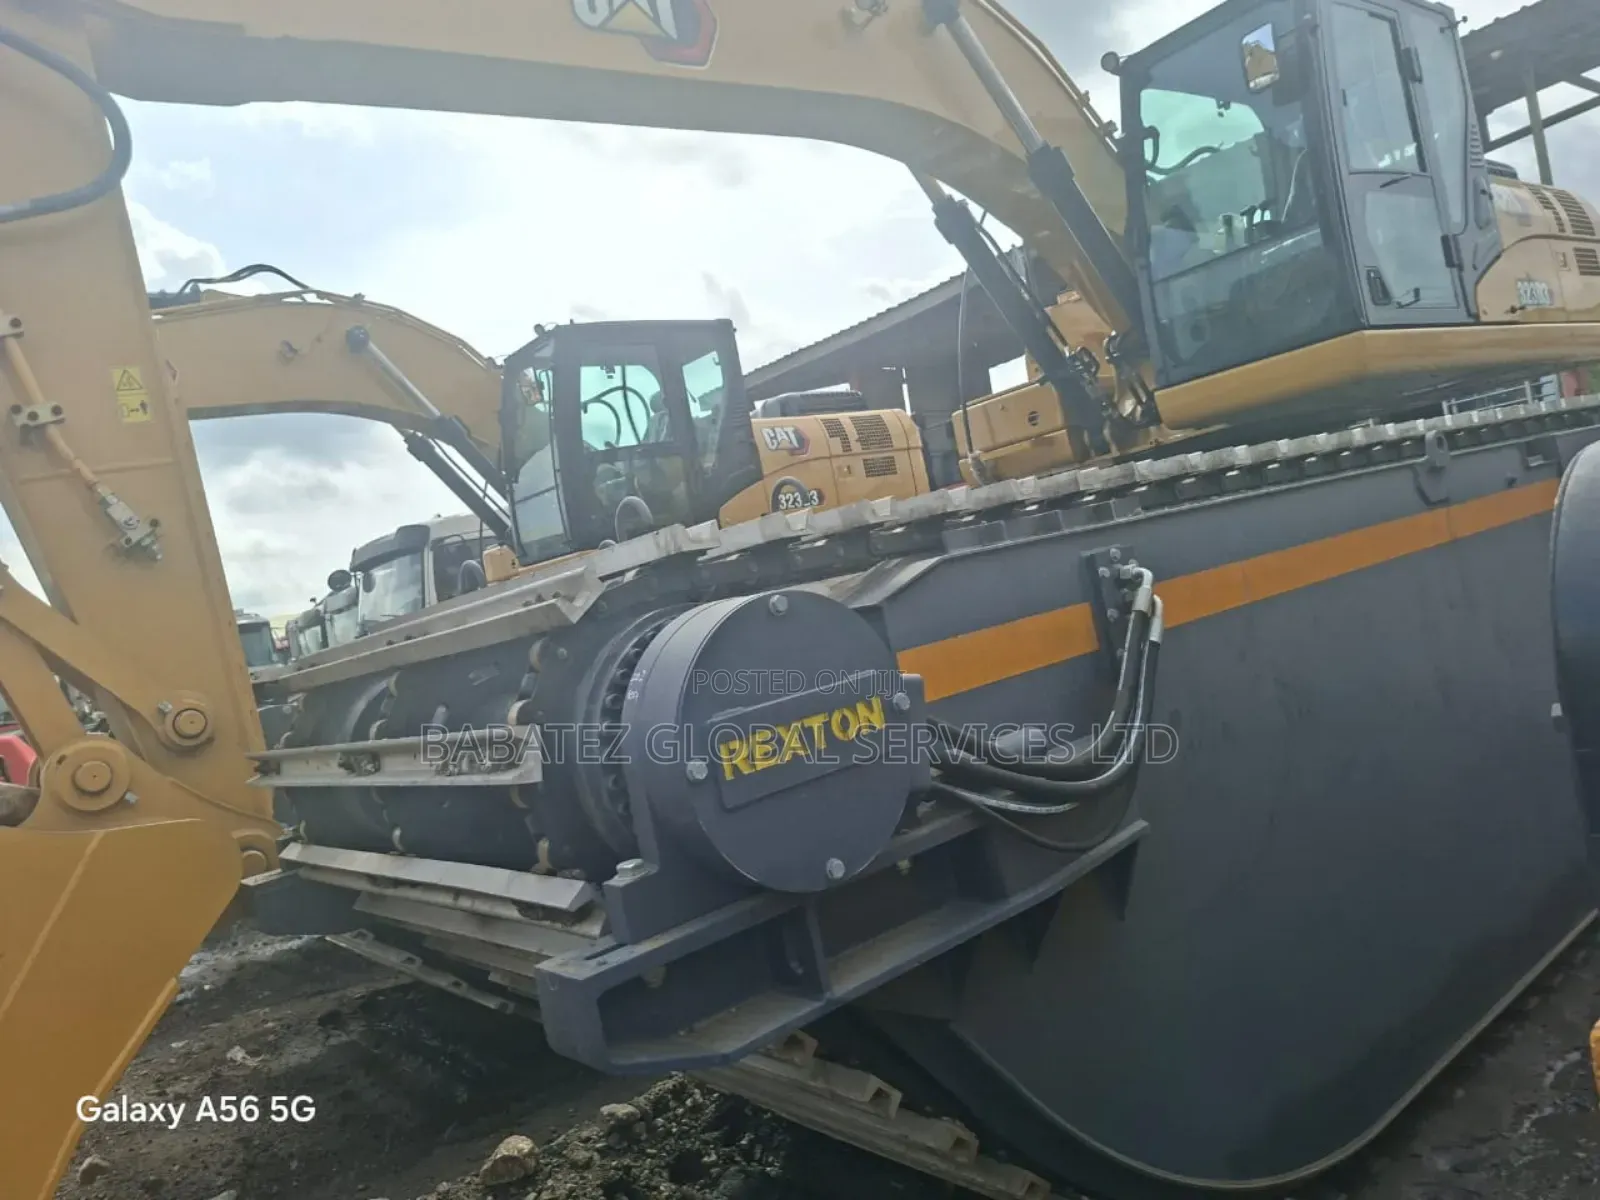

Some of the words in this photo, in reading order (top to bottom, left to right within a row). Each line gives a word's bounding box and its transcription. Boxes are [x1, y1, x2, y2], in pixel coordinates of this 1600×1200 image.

[762, 427, 799, 450] CAT
[778, 490, 819, 510] 3233
[719, 697, 886, 781] REXTON
